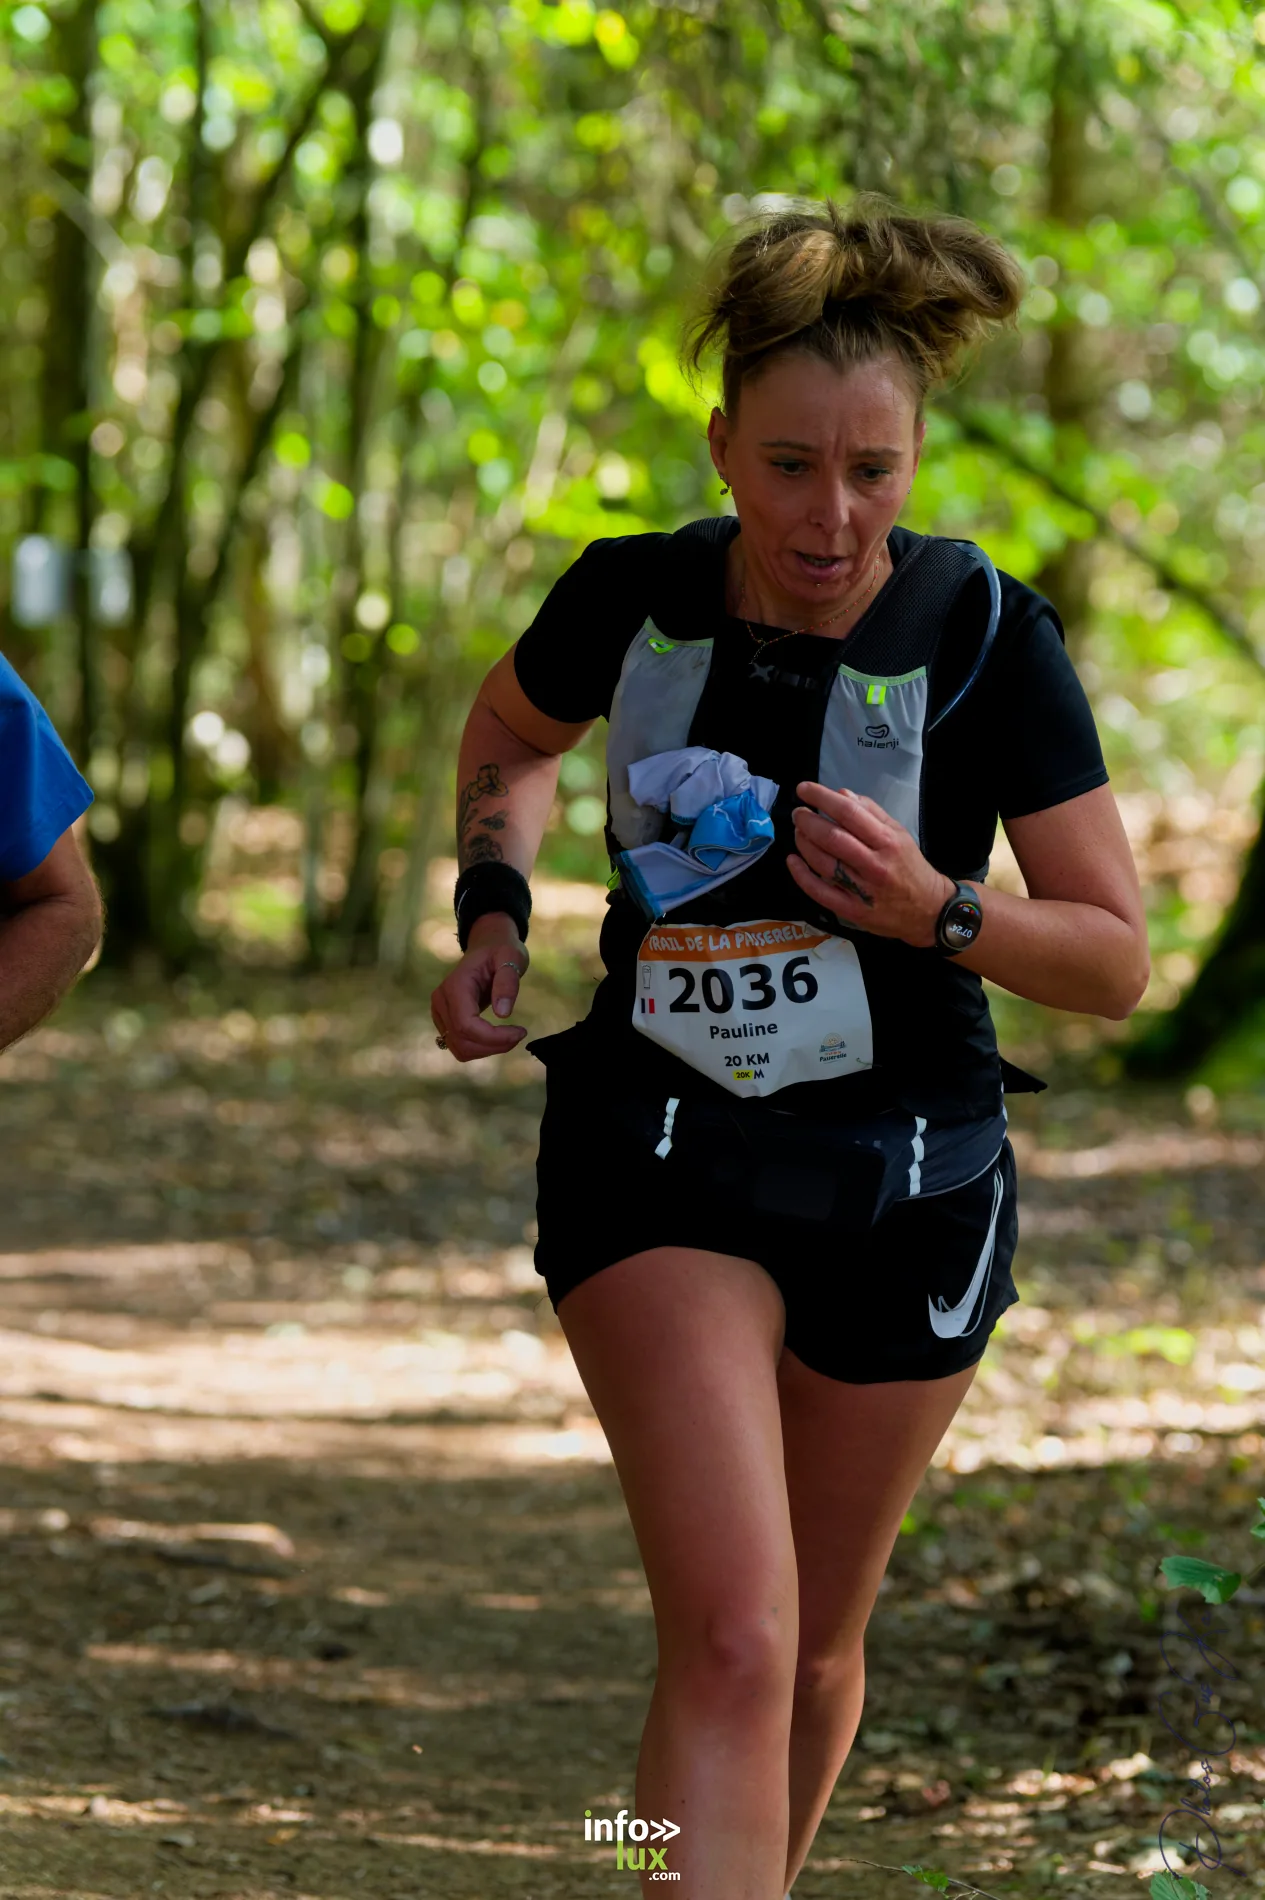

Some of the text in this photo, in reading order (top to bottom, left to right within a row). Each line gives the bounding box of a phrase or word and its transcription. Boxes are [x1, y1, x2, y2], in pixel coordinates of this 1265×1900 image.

[857, 736, 900, 749] Kalenji
[685, 935, 705, 952] DE
[708, 934, 733, 951] LA
[735, 925, 811, 949] PASSEREL
[668, 956, 819, 1014] 2036
[709, 1022, 779, 1040] Pauline
[724, 1052, 770, 1067] 20 KM
[735, 1068, 765, 1079] 20K M
